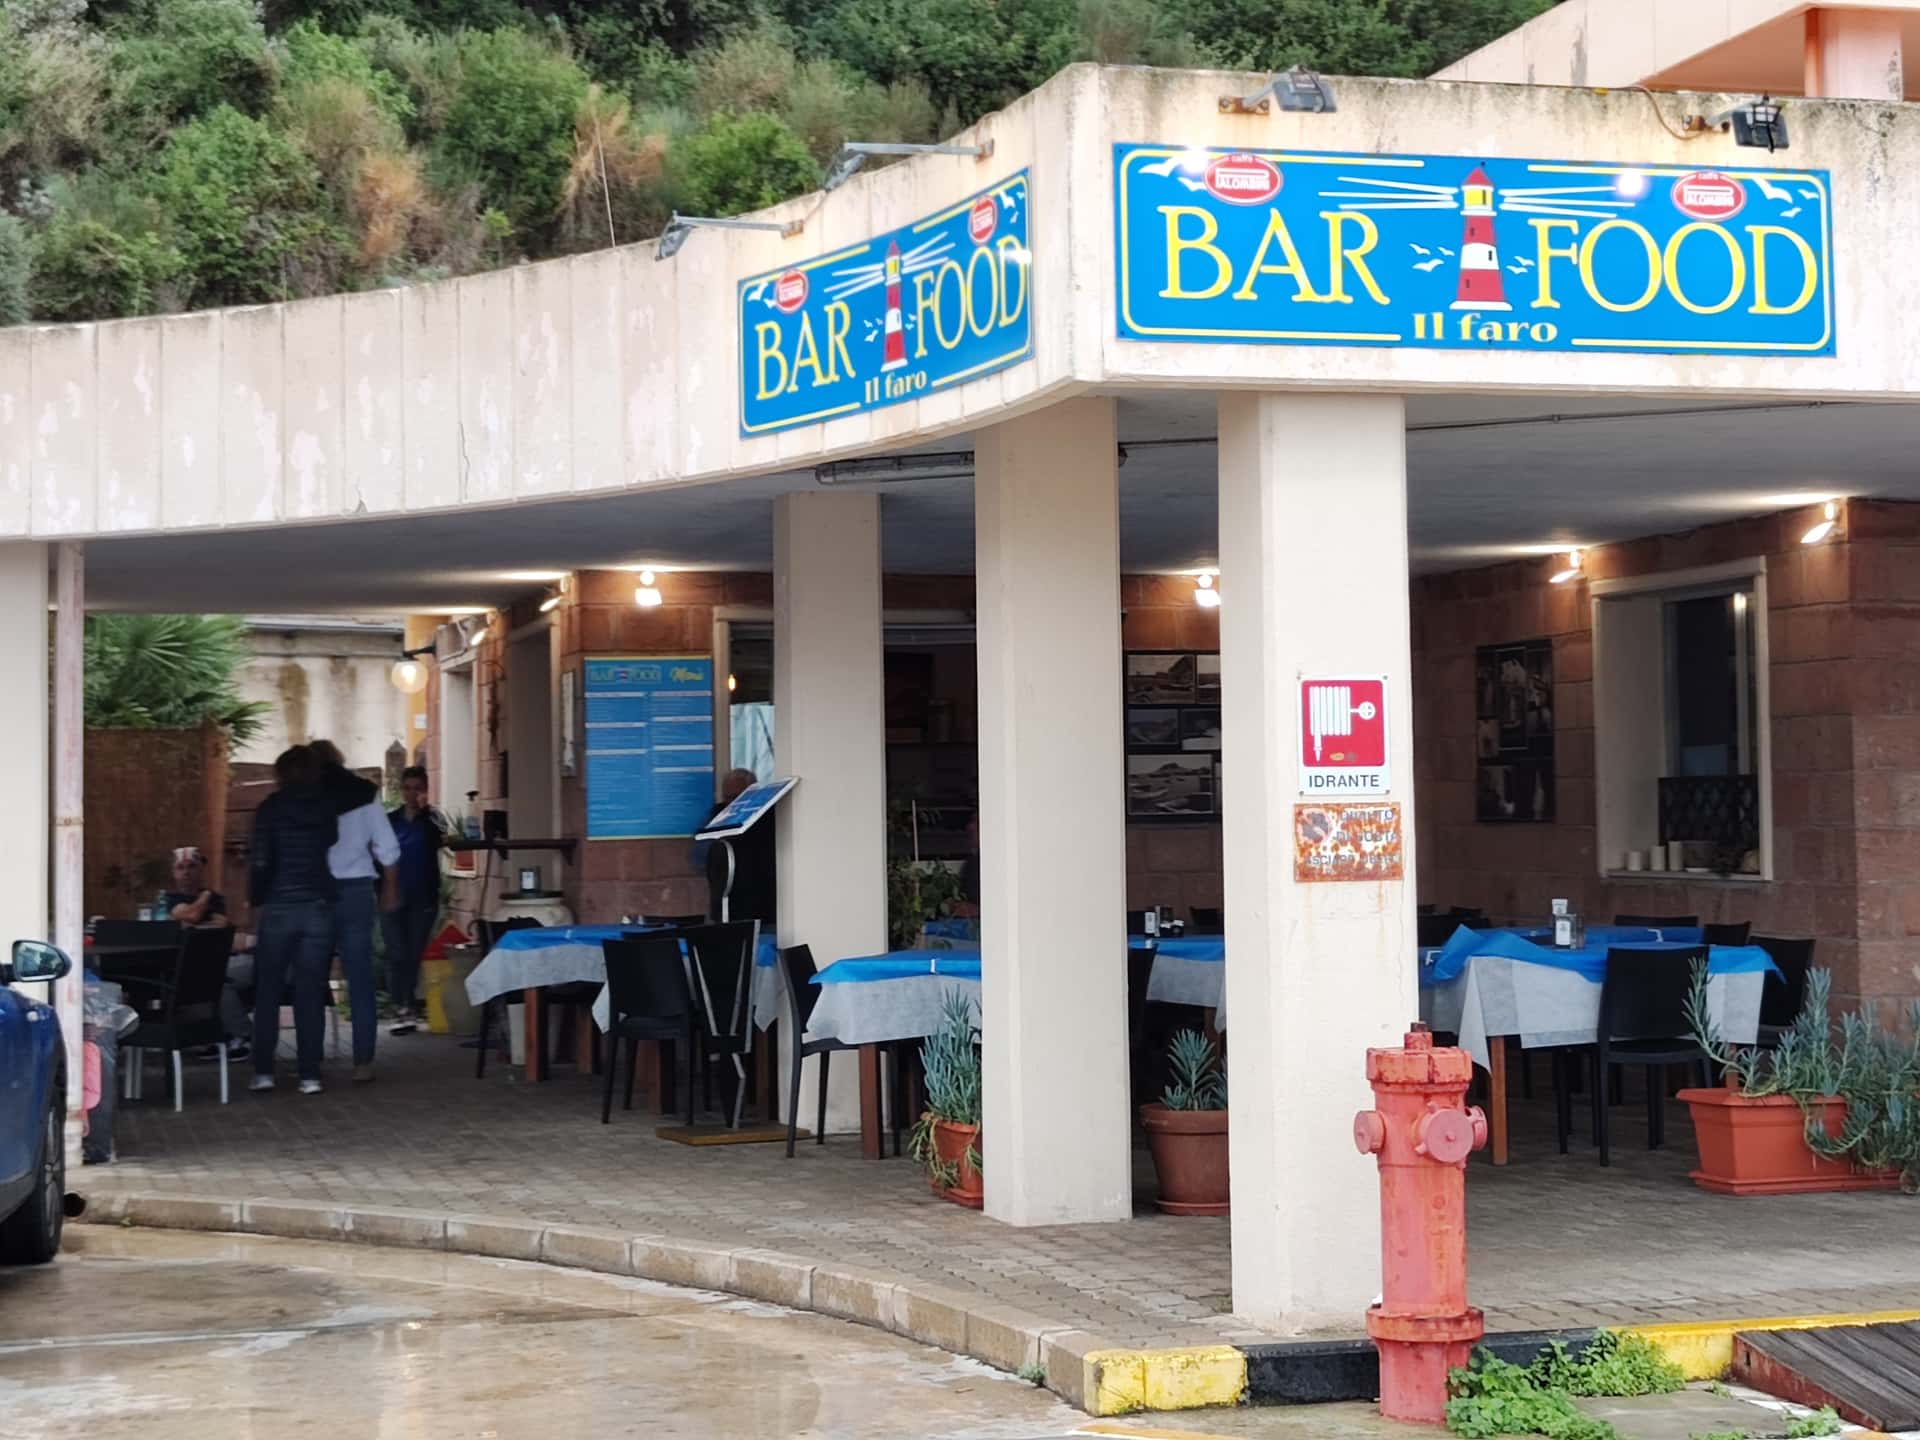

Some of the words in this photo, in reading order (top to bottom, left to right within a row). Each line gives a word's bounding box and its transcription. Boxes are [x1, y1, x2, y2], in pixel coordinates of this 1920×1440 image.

[1157, 204, 1391, 306] BAR
[1528, 217, 1819, 316] FOOD
[754, 301, 857, 401] BAR
[912, 235, 1028, 359] FOOD
[1413, 311, 1444, 341] Il
[1456, 310, 1559, 343] faro
[864, 376, 880, 404] Il
[885, 370, 928, 399] faro
[1308, 774, 1380, 788] IDRANTE
